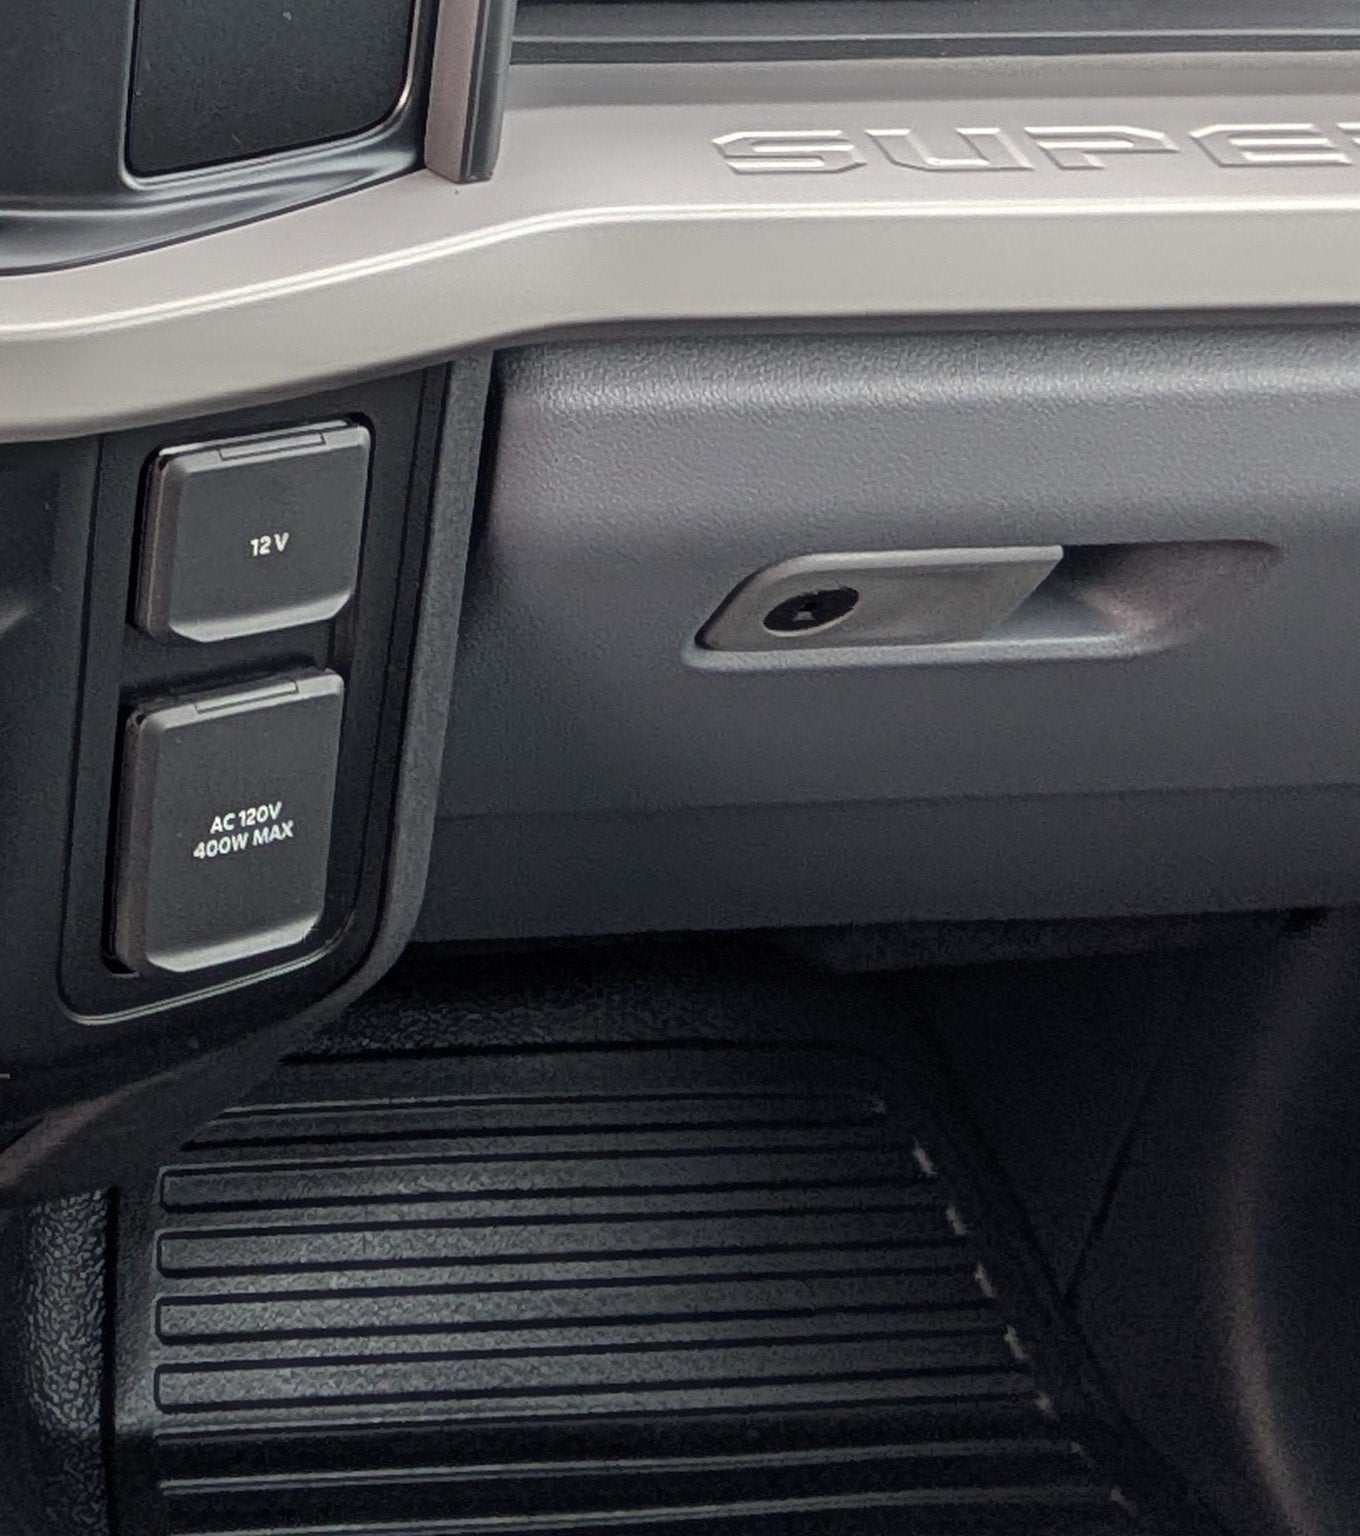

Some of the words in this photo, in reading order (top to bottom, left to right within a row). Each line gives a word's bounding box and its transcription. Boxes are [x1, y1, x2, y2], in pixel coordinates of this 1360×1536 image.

[712, 122, 1360, 176] SUPE
[250, 535, 271, 557] 12
[273, 532, 290, 553] V
[209, 813, 235, 835] AC
[238, 801, 283, 828] 120V
[193, 834, 250, 859] 400W
[251, 819, 294, 846] MAX
